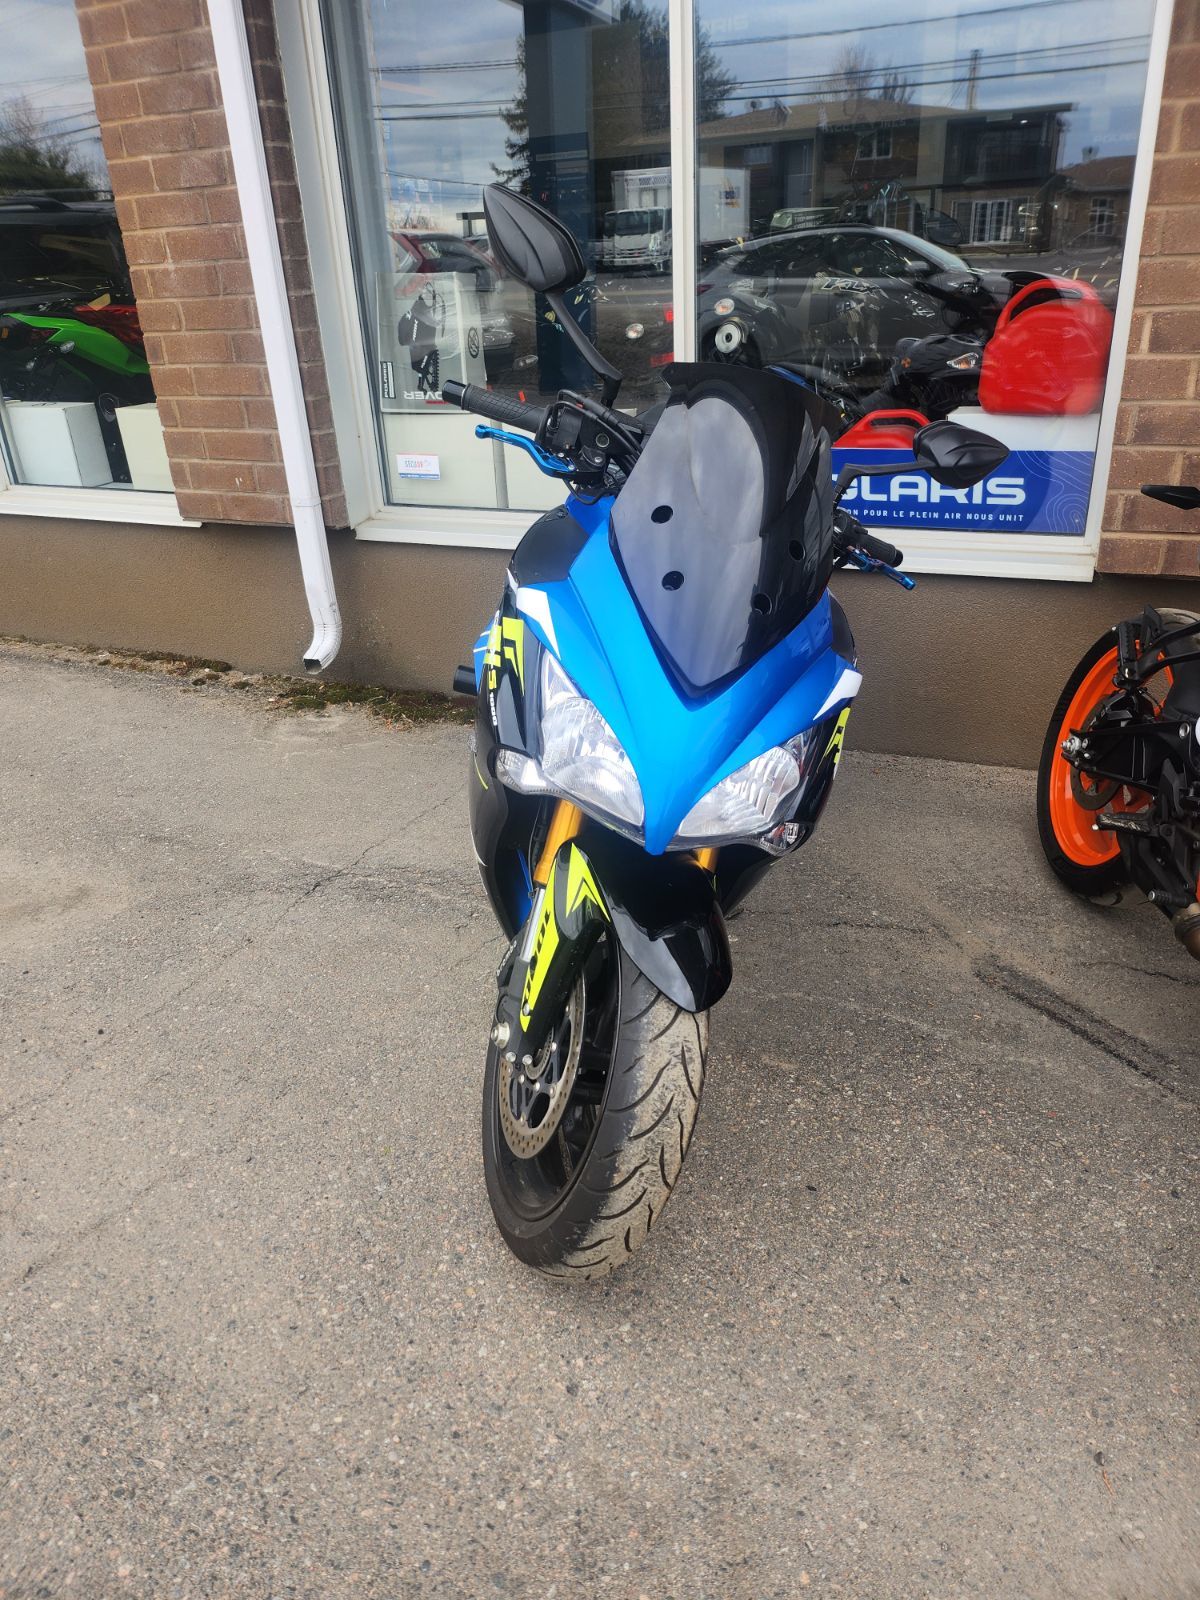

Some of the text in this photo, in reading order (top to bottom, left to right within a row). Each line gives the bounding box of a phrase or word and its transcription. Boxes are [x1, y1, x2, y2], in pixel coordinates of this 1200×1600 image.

[403, 391, 443, 400] OVER
[831, 473, 1026, 506] LARIS
[863, 509, 888, 517] POUR
[893, 510, 905, 518] LE
[909, 511, 939, 519] PLEIN
[944, 512, 961, 520] AIR
[998, 514, 1024, 522] UNIT
